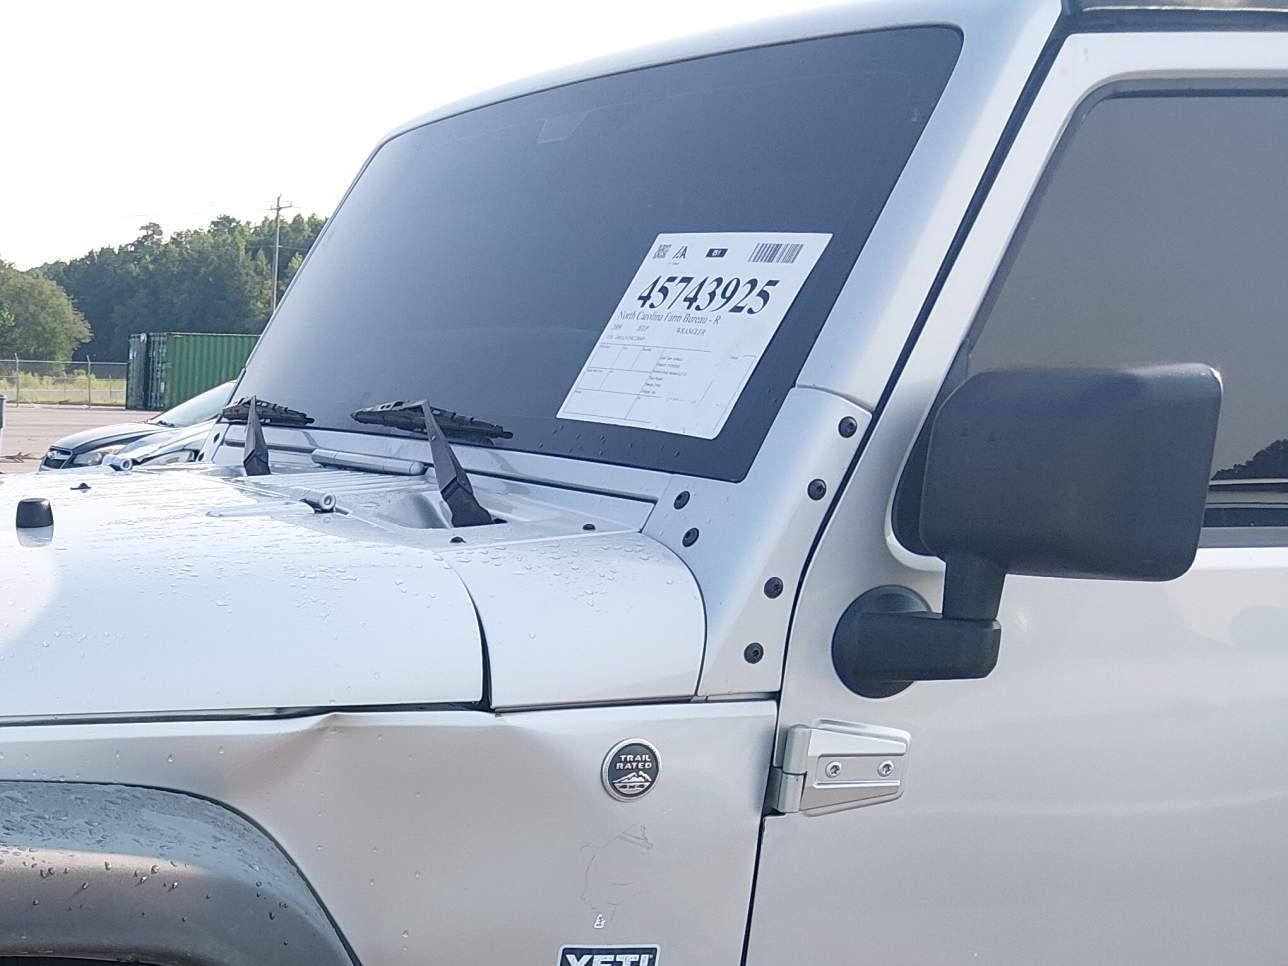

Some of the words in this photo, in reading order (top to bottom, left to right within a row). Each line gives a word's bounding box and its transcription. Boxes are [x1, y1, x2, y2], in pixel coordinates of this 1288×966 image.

[637, 276, 780, 314] 45743925
[665, 314, 683, 323] Farm
[619, 754, 652, 762] TRAIL
[615, 762, 652, 770] RATED
